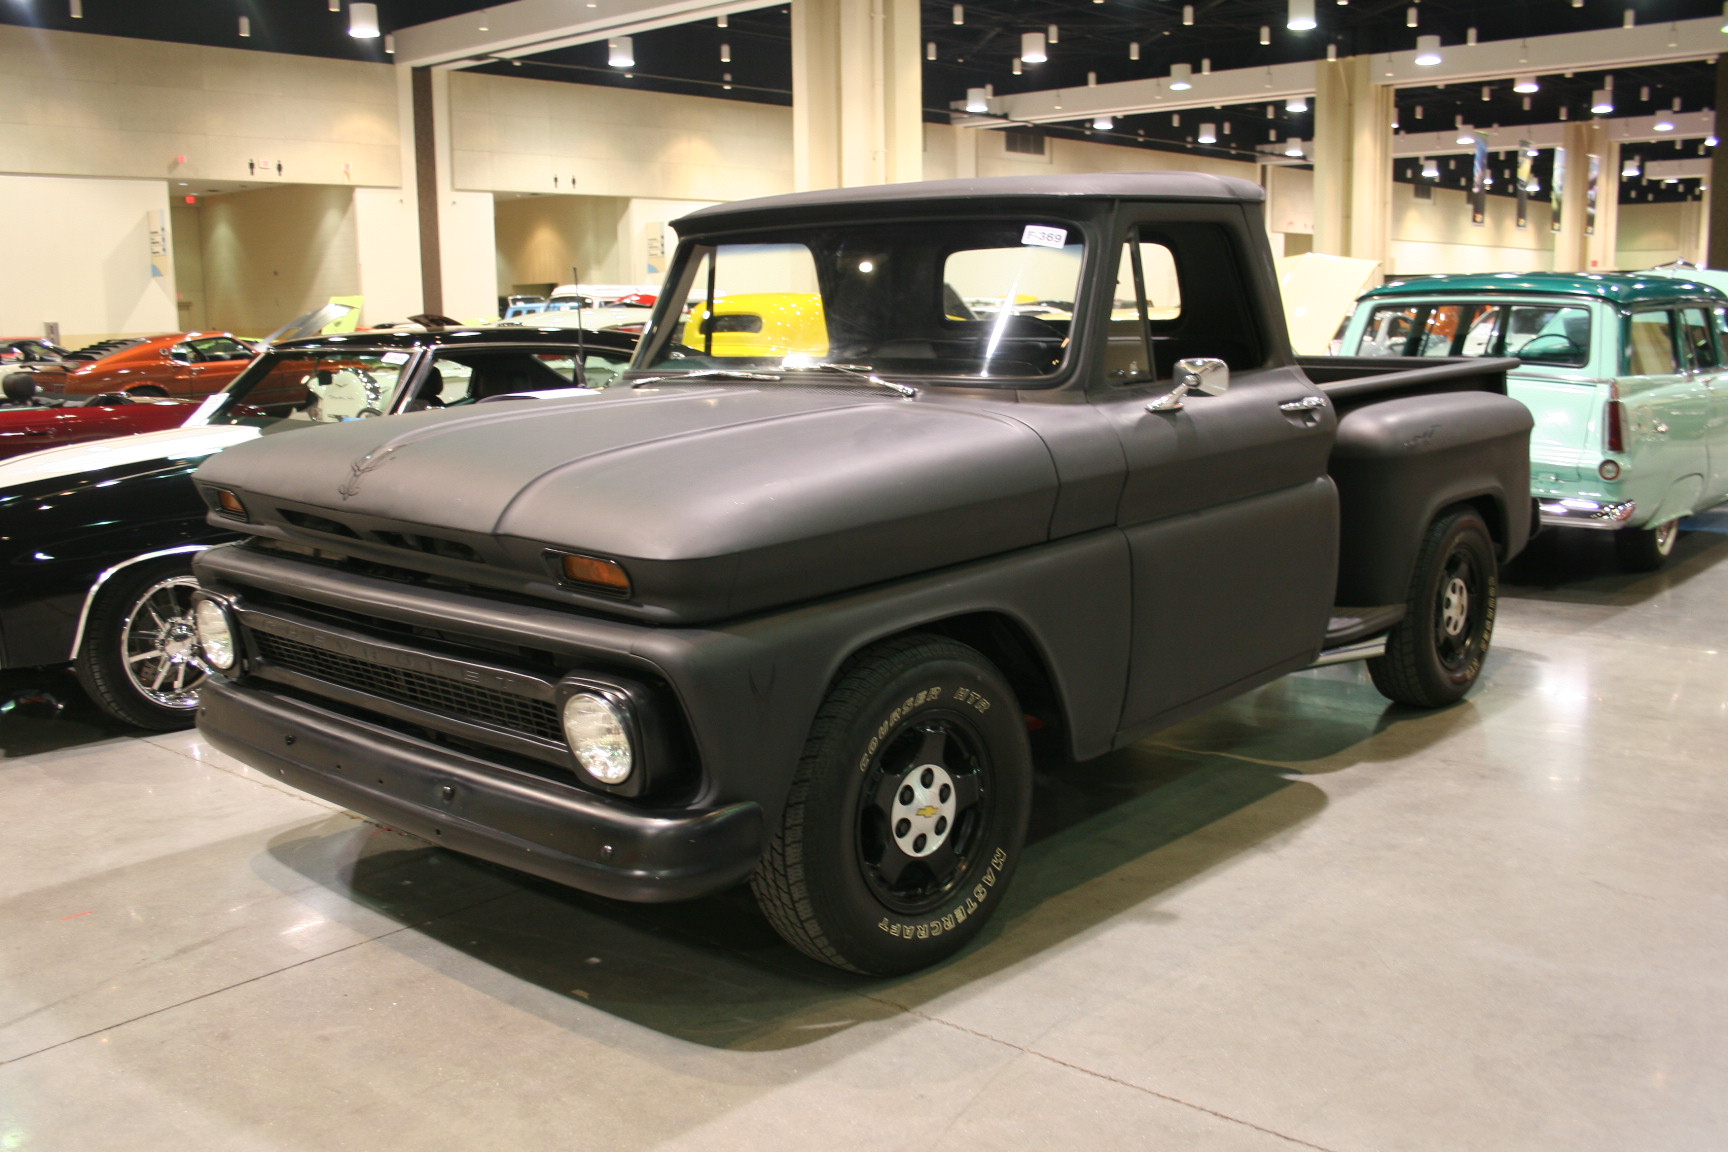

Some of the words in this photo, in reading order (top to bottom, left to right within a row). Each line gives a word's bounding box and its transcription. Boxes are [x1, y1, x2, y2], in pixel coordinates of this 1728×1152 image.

[261, 619, 516, 691] CHEVROLET
[859, 686, 942, 773] COURSER
[953, 686, 992, 715] HTR
[878, 847, 1007, 940] MASTERCRAFT
